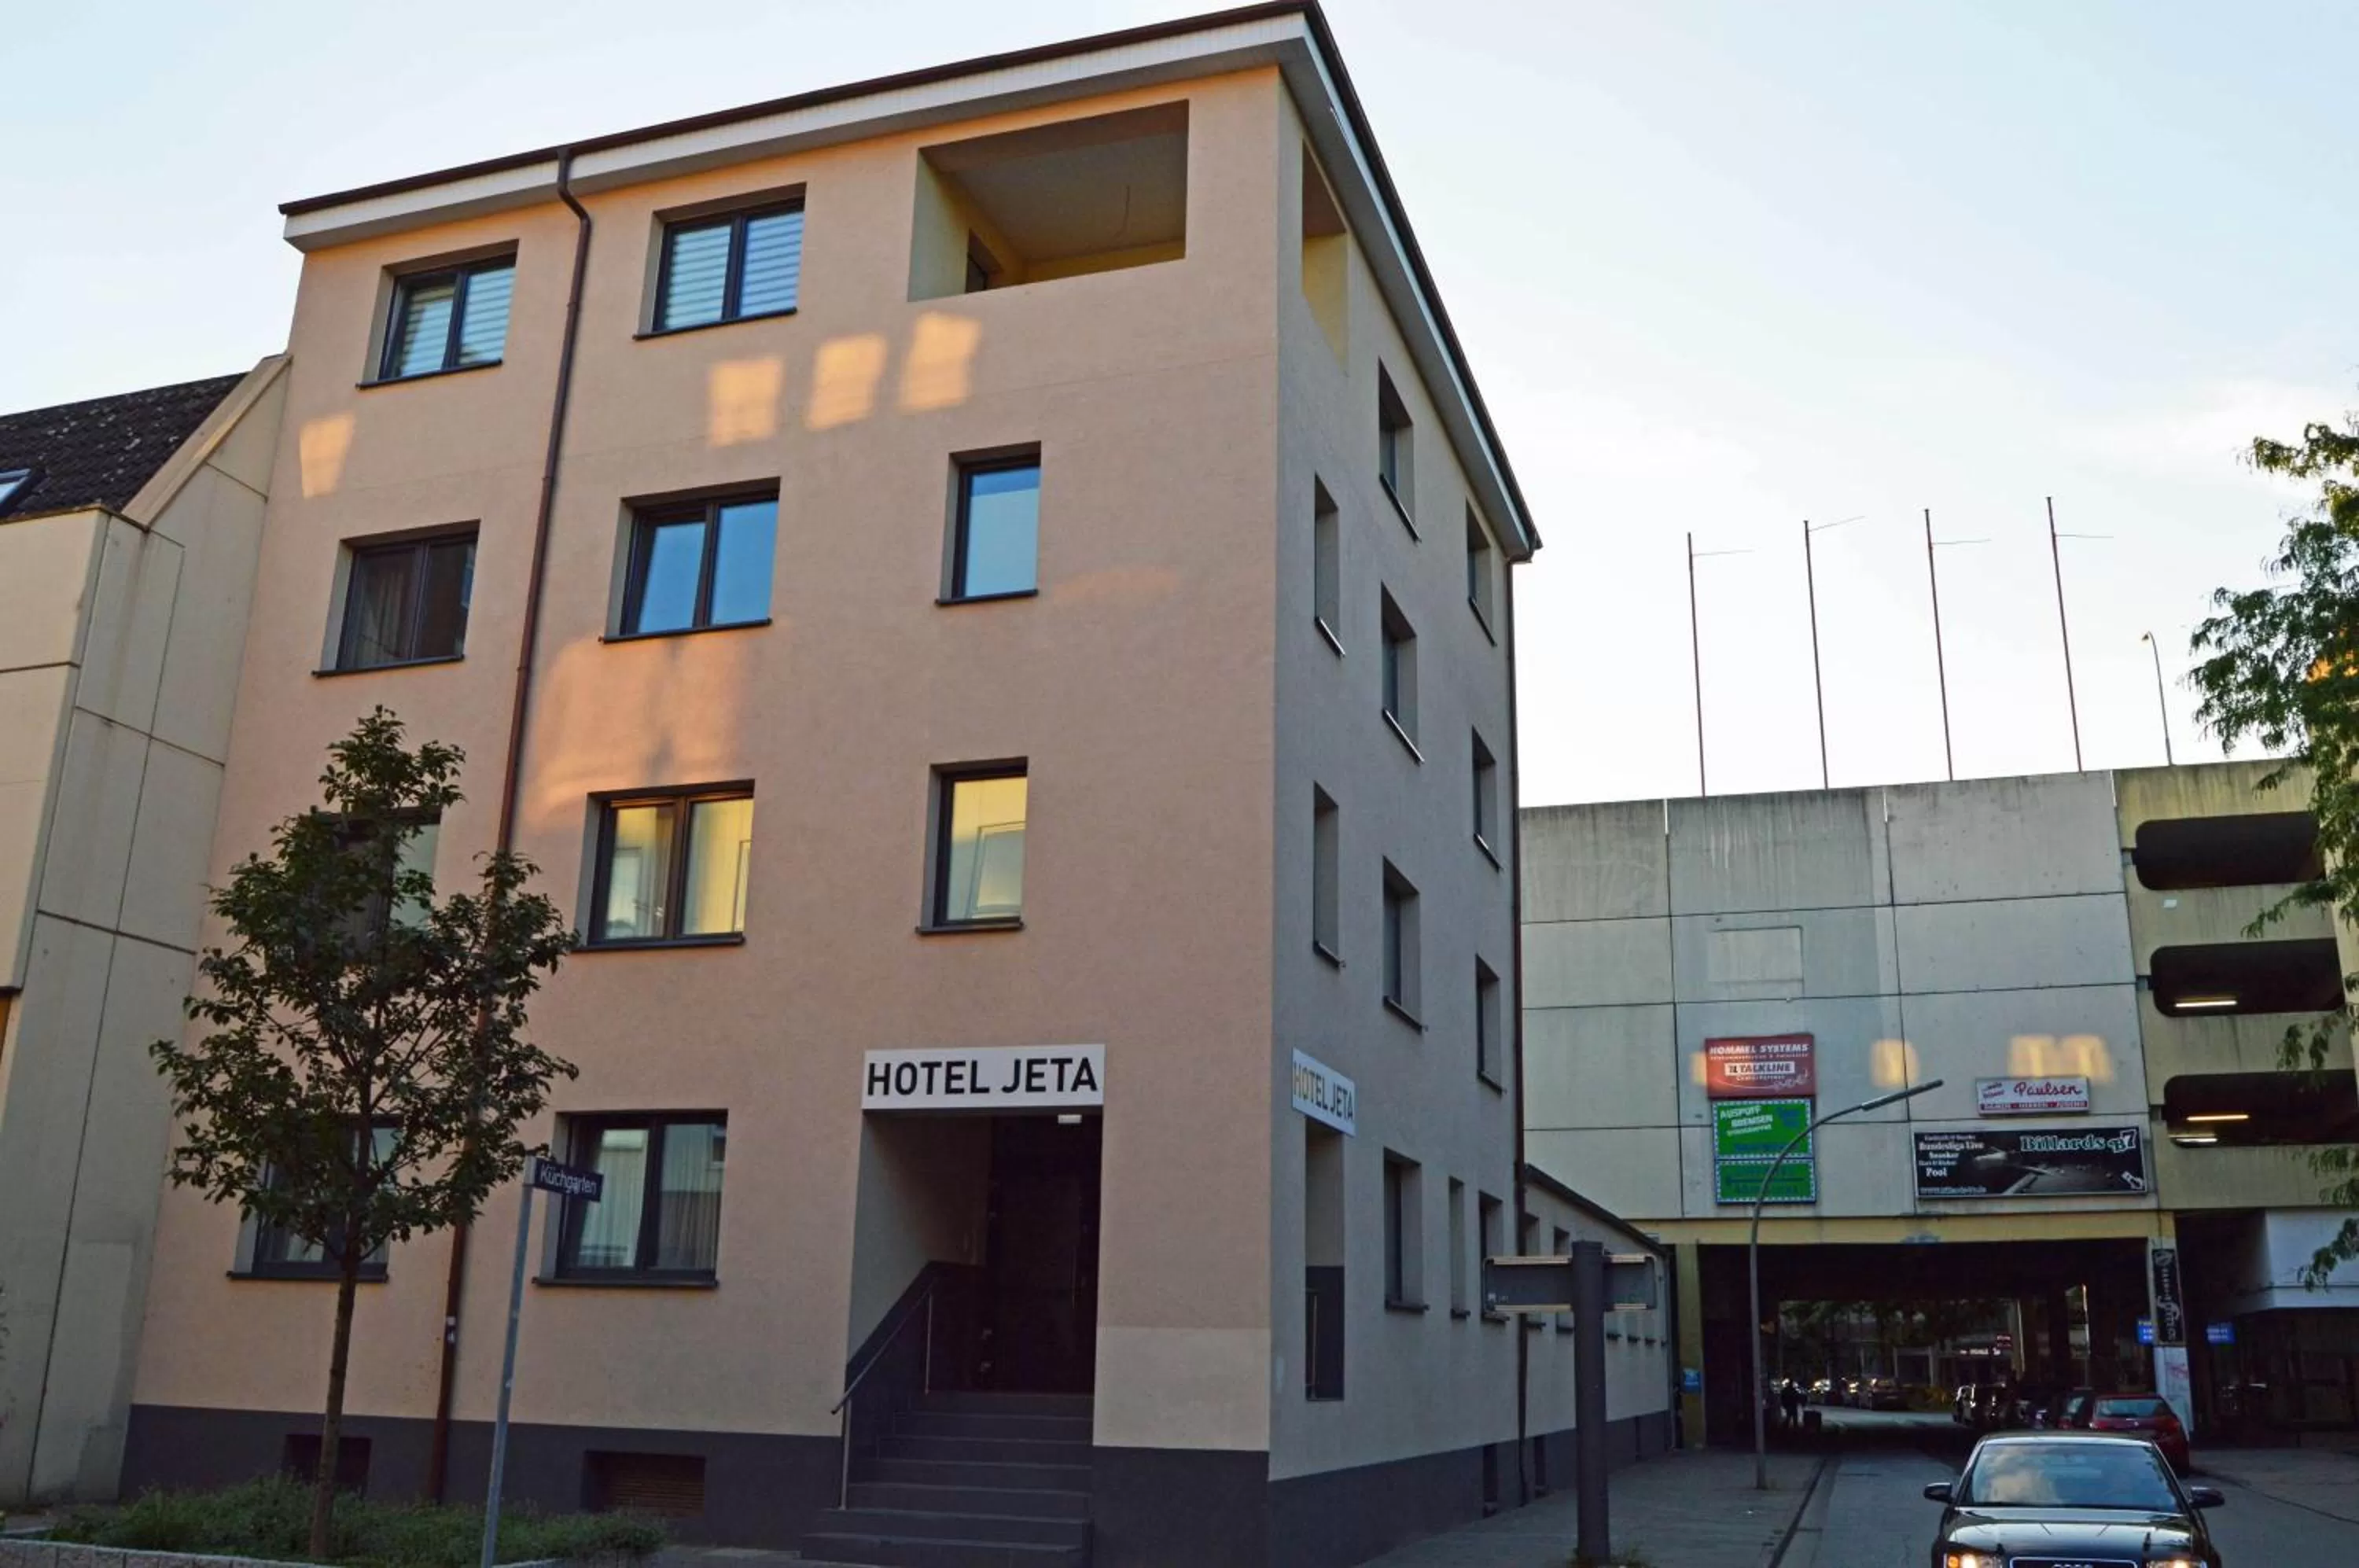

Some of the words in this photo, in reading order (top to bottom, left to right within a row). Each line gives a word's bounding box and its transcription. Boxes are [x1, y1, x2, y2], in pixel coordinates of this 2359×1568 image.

[1760, 1043, 1809, 1053] SYSTEMS
[867, 1059, 990, 1095] HOTEL
[1002, 1057, 1098, 1094] JETA
[1293, 1060, 1328, 1110] HOTEL
[1330, 1081, 1353, 1121] JETA
[2013, 1081, 2083, 1097] Paulsen
[2019, 1134, 2105, 1152] Billards
[1926, 1167, 1948, 1177] Pool
